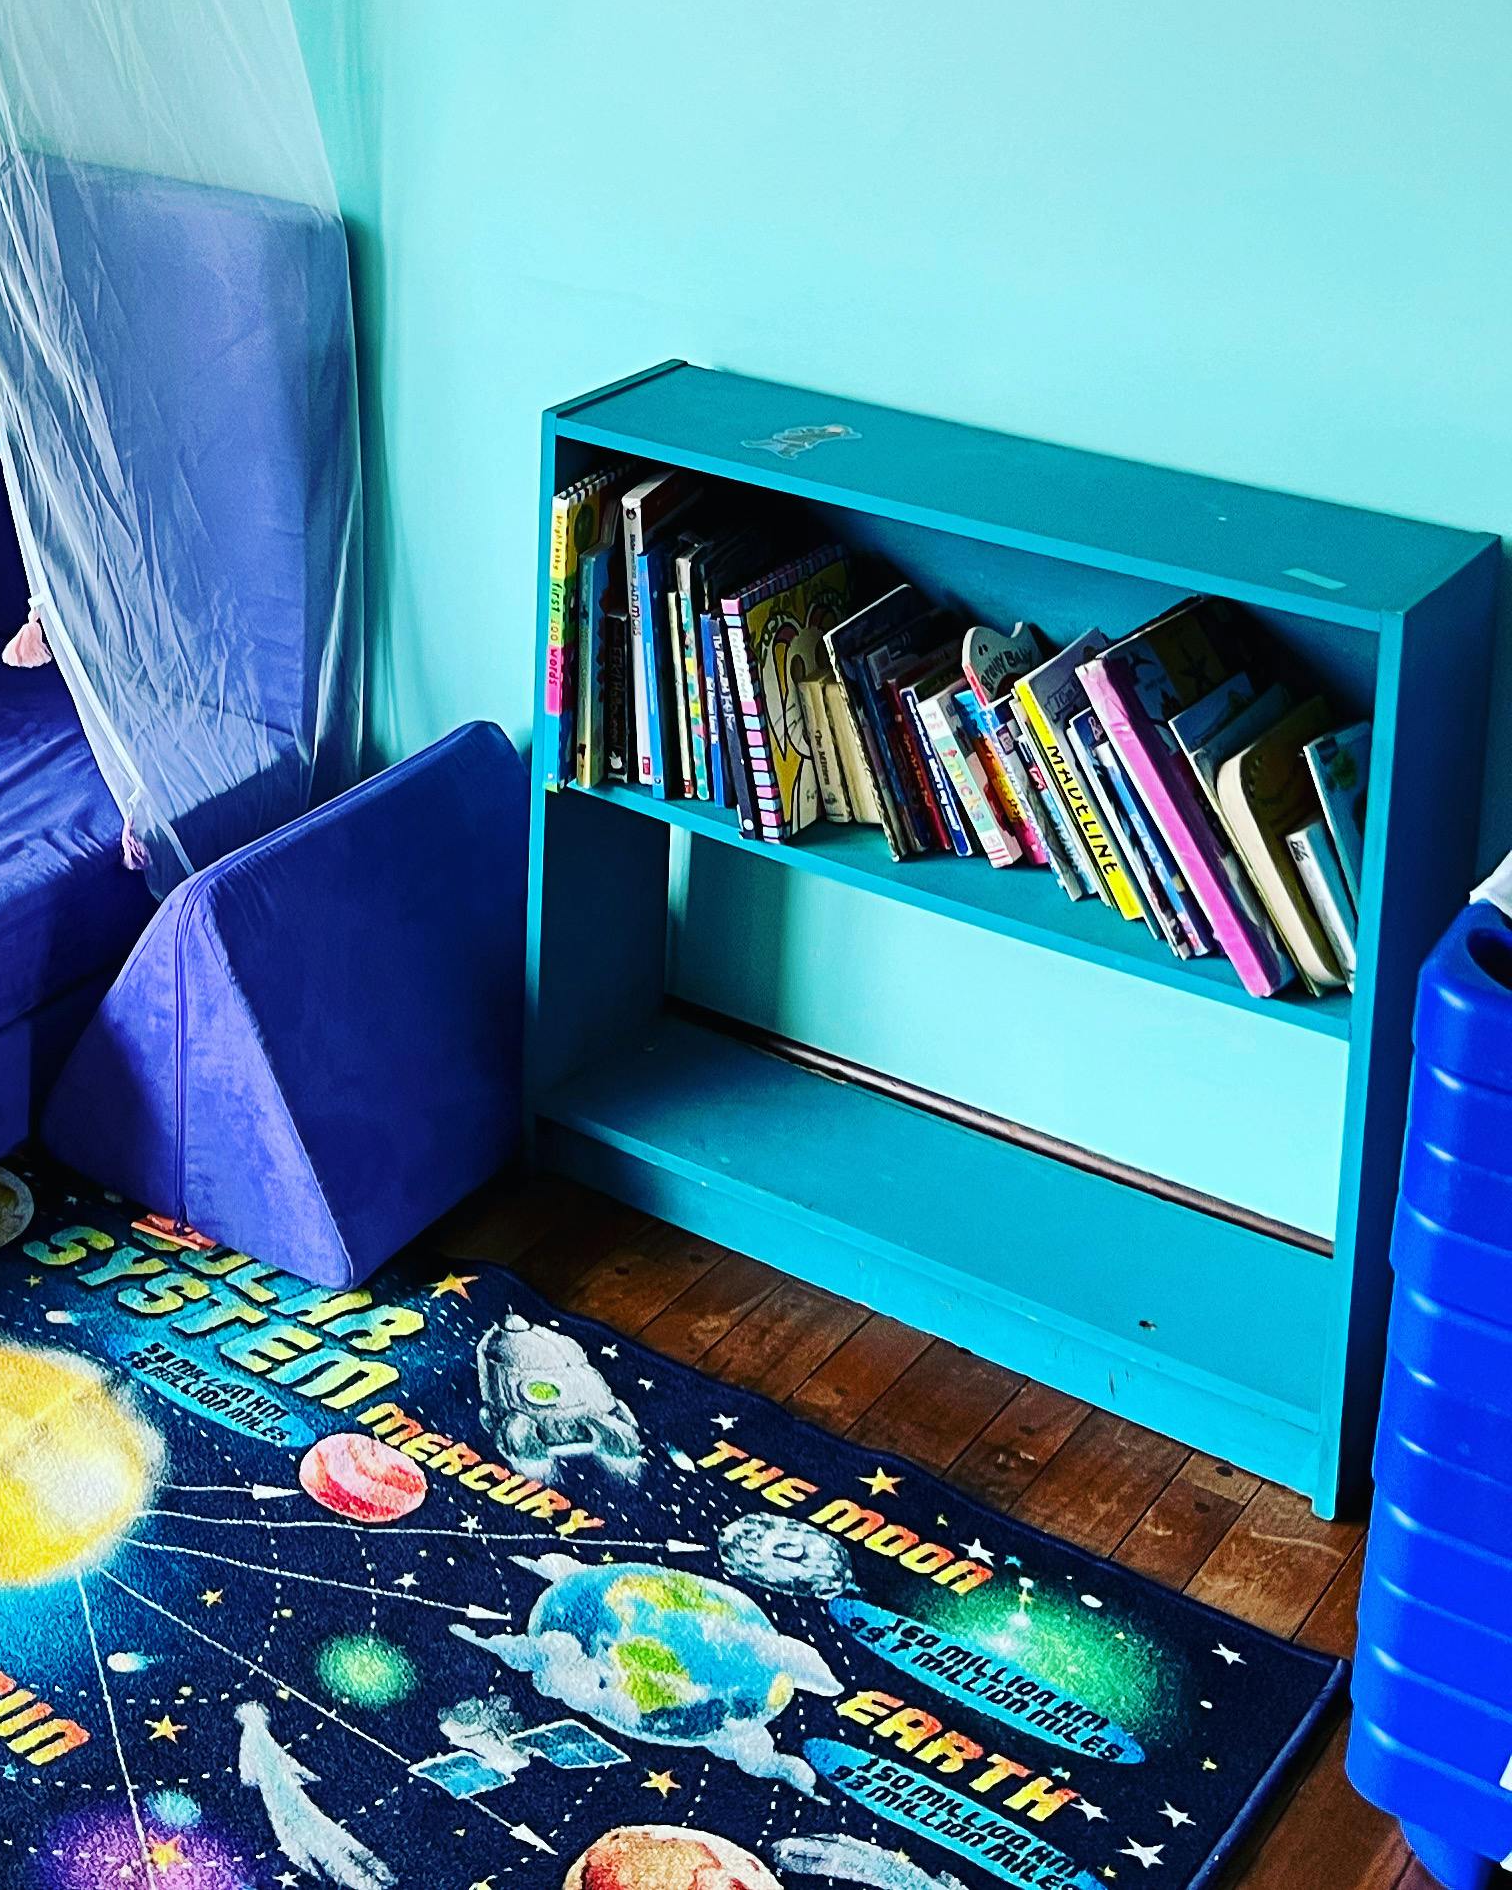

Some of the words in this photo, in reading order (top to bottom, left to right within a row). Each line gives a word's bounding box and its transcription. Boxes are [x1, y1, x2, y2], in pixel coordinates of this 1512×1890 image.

[549, 619, 560, 643] 100
[551, 582, 564, 613] first
[548, 648, 560, 686] words
[23, 1225, 400, 1410] SYSTEM
[133, 1231, 425, 1352] OLAR
[225, 1407, 293, 1443] MILES
[356, 1402, 605, 1536] MERCURY
[696, 1439, 819, 1509] THE
[807, 1497, 995, 1597] MOON
[884, 1617, 941, 1649] 160
[935, 1644, 1060, 1708] MILLION
[1053, 1700, 1111, 1733] KM
[910, 1651, 1031, 1716] MILLION
[1025, 1708, 1126, 1761] MILES
[834, 1689, 1080, 1823] EARTH
[856, 1752, 916, 1792] 150
[906, 1780, 1032, 1852] MILLION
[1025, 1845, 1080, 1879] KM
[866, 1786, 989, 1849] MILLION
